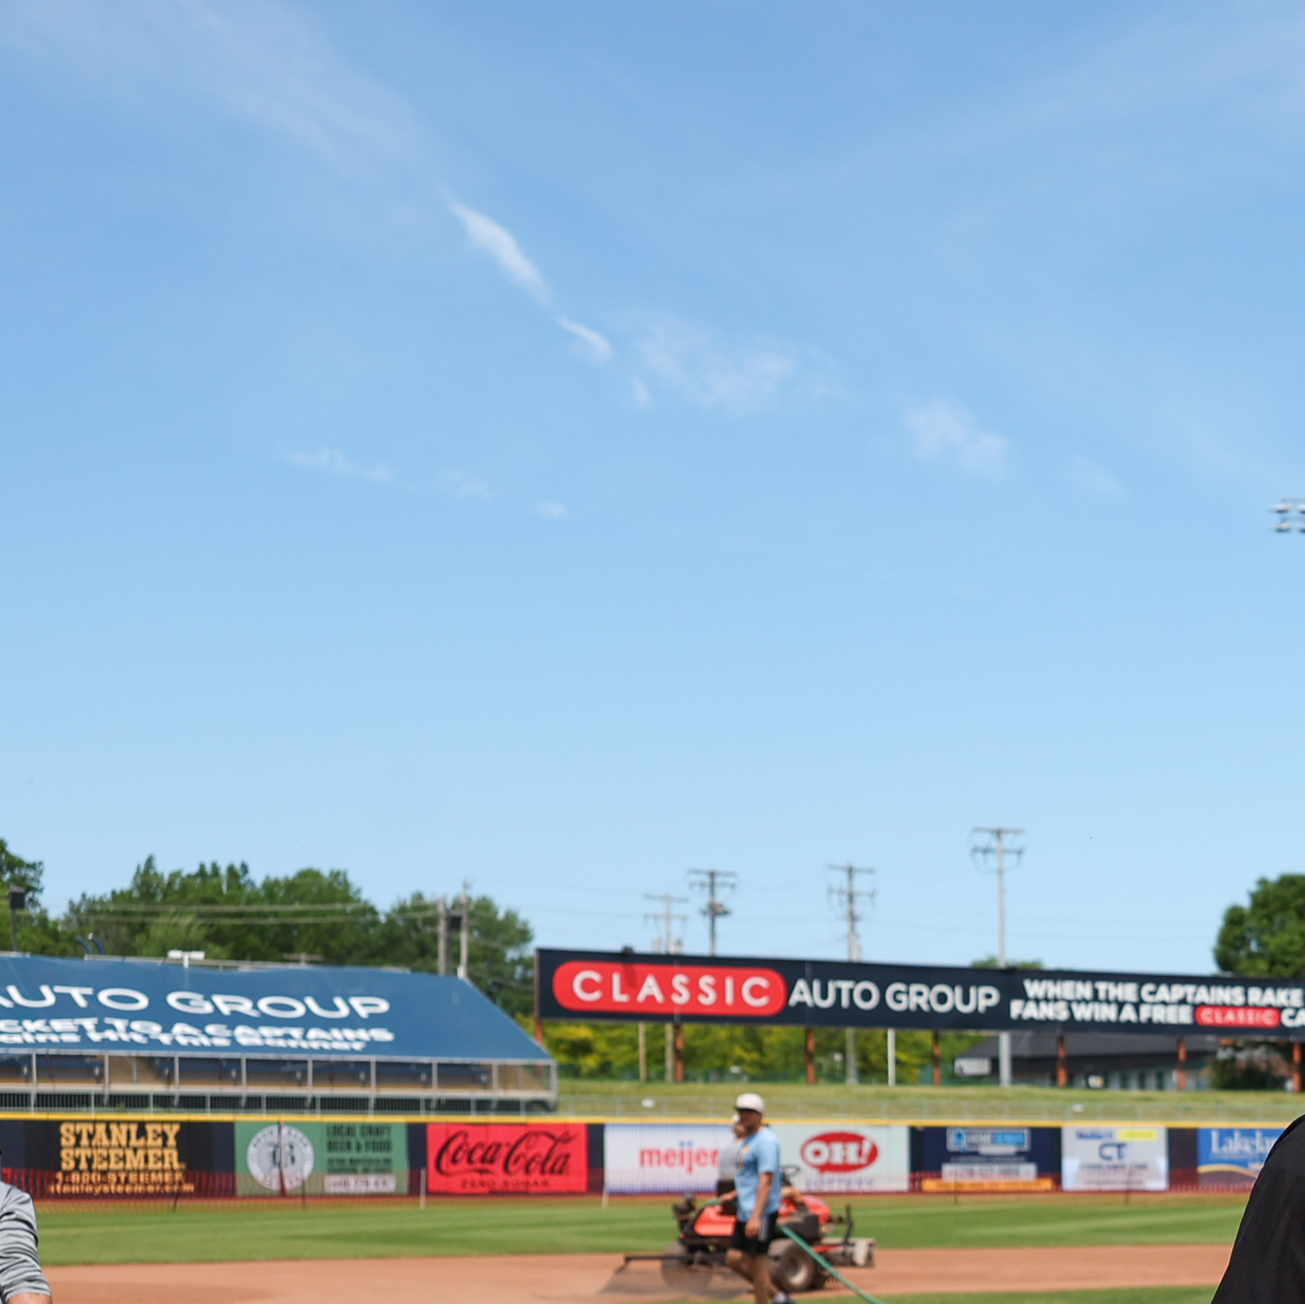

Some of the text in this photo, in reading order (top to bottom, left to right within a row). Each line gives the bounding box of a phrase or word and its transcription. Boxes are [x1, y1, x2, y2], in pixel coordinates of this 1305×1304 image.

[166, 990, 391, 1019] GROUP
[571, 970, 1000, 1014] CLASSIC AUTO GROUP
[1023, 979, 1092, 1001] WHEN
[1096, 981, 1138, 1002] THE
[1140, 983, 1246, 1007] CAPTAINS
[1248, 987, 1304, 1009] RAKE
[1010, 1000, 1070, 1022] FANS
[1071, 1002, 1117, 1023] WIN
[1118, 1003, 1138, 1024] A
[1139, 1004, 1194, 1025] FREE
[1200, 1008, 1276, 1026] CLASSIC
[59, 1122, 181, 1147] STANLEY
[435, 1129, 577, 1177] Coca-Cola
[639, 1140, 719, 1174] meijer
[804, 1139, 873, 1166] OH!
[461, 1179, 549, 1189] ZERO SUGAR
